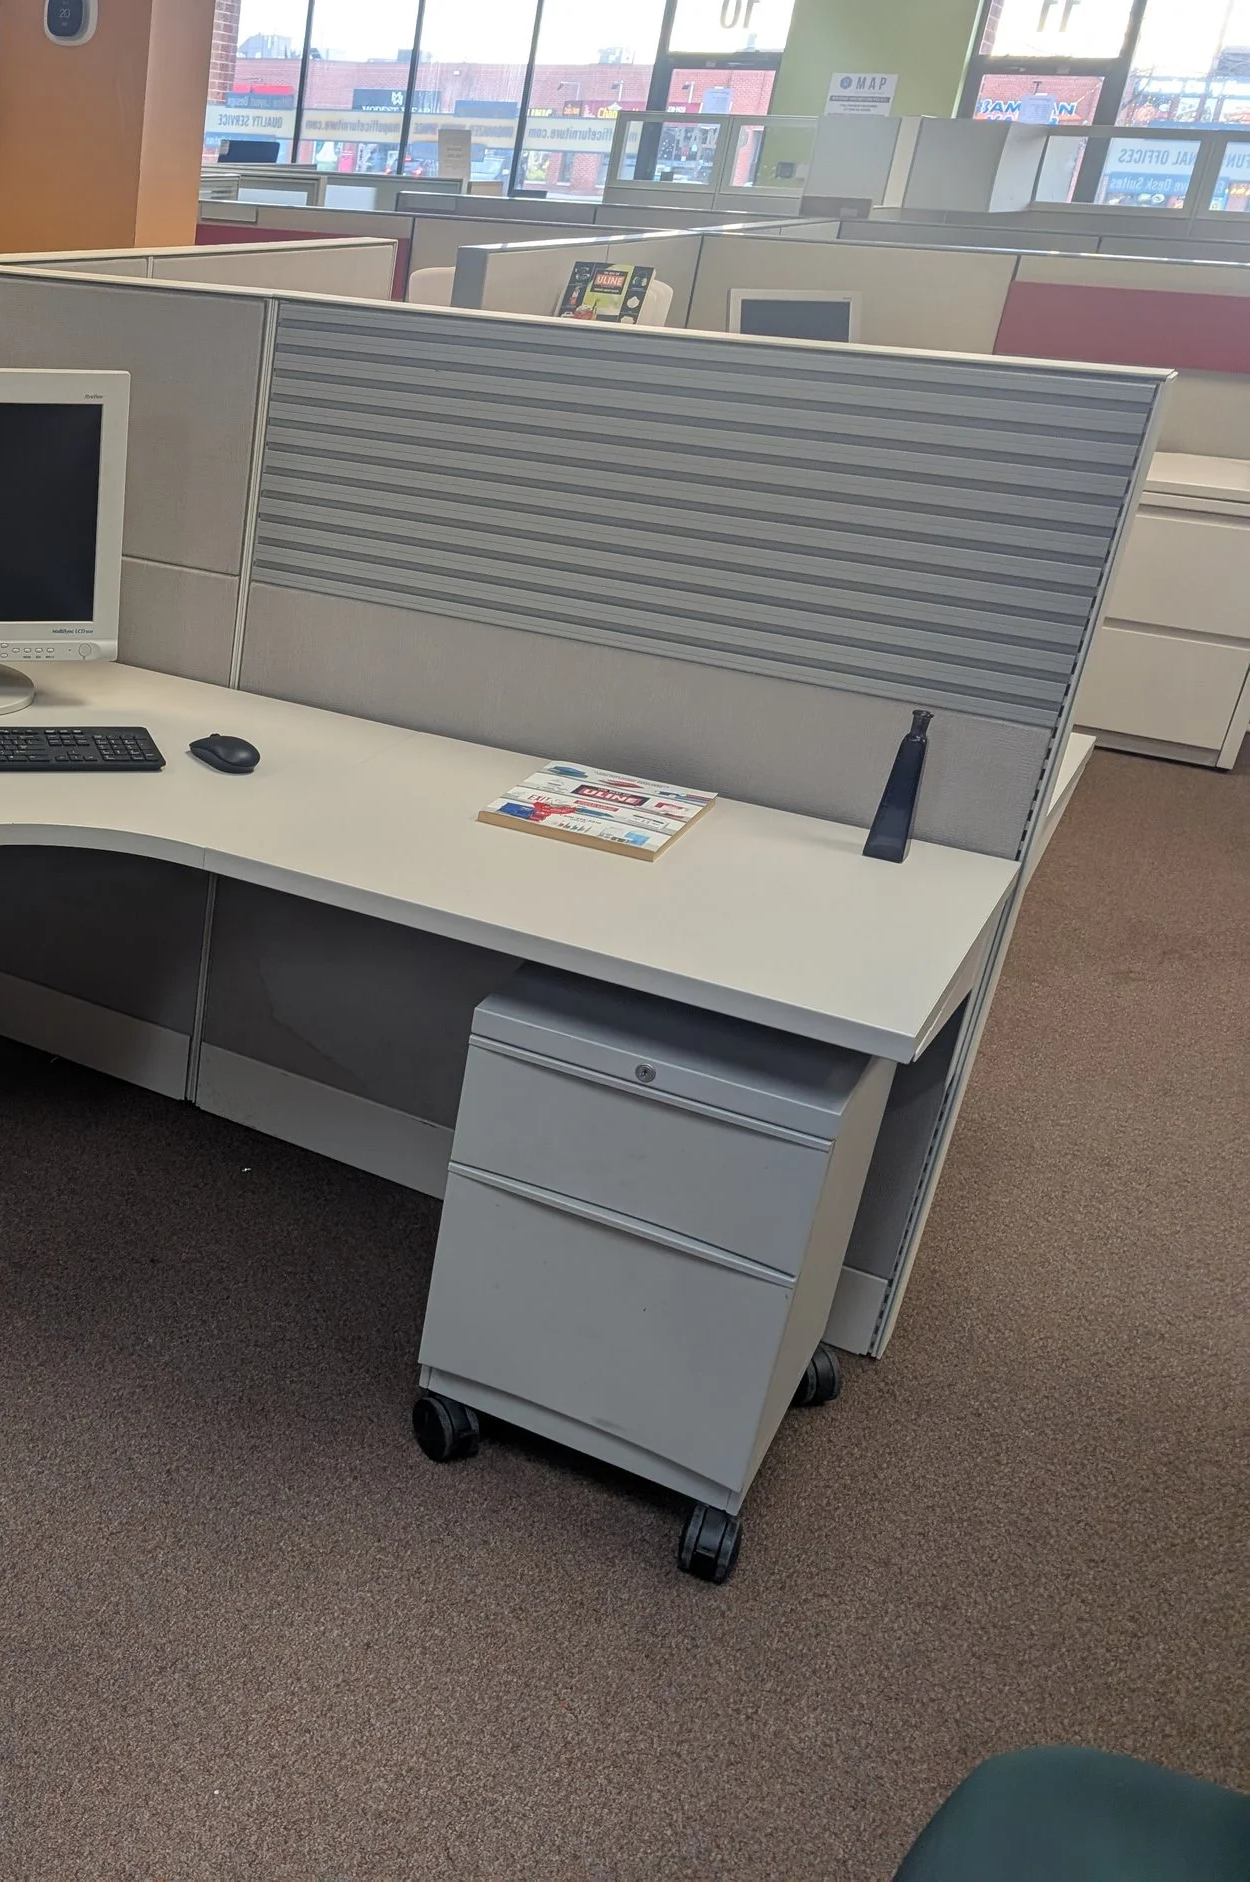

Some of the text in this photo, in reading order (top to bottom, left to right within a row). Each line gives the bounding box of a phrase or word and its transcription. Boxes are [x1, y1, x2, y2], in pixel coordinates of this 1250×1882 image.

[856, 76, 887, 90] MAP
[977, 99, 1078, 116] BAMAN
[597, 275, 623, 285] ULINE
[582, 788, 638, 803] ULINE
